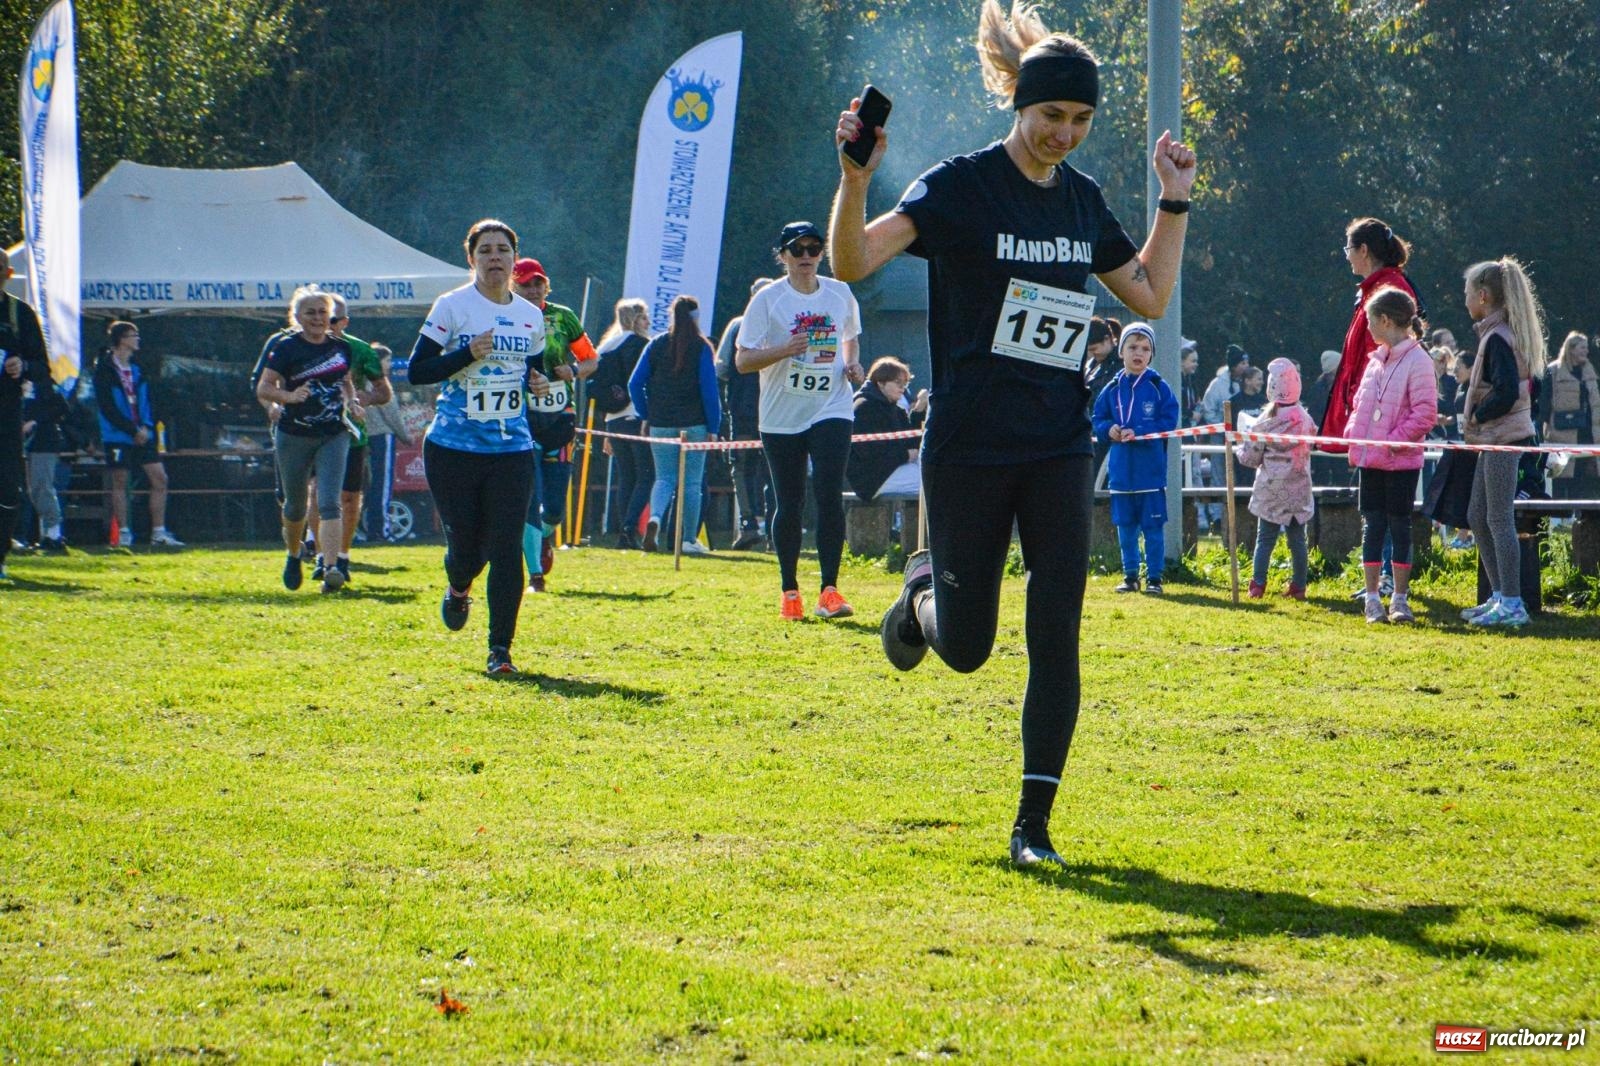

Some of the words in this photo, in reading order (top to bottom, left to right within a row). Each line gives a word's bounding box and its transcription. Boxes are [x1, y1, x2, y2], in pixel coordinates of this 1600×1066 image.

[665, 139, 699, 219] STOWARZYSZENIE
[660, 220, 689, 264] AKTYWNI
[996, 233, 1092, 264] HANDBALL
[657, 264, 683, 283] DLA
[187, 282, 245, 300] AKTYWNI
[257, 283, 283, 300] DLA
[374, 281, 414, 300] JUTRA
[1007, 309, 1085, 354] 157
[789, 373, 830, 391] 192
[473, 390, 520, 411] 178
[531, 391, 565, 407] 180
